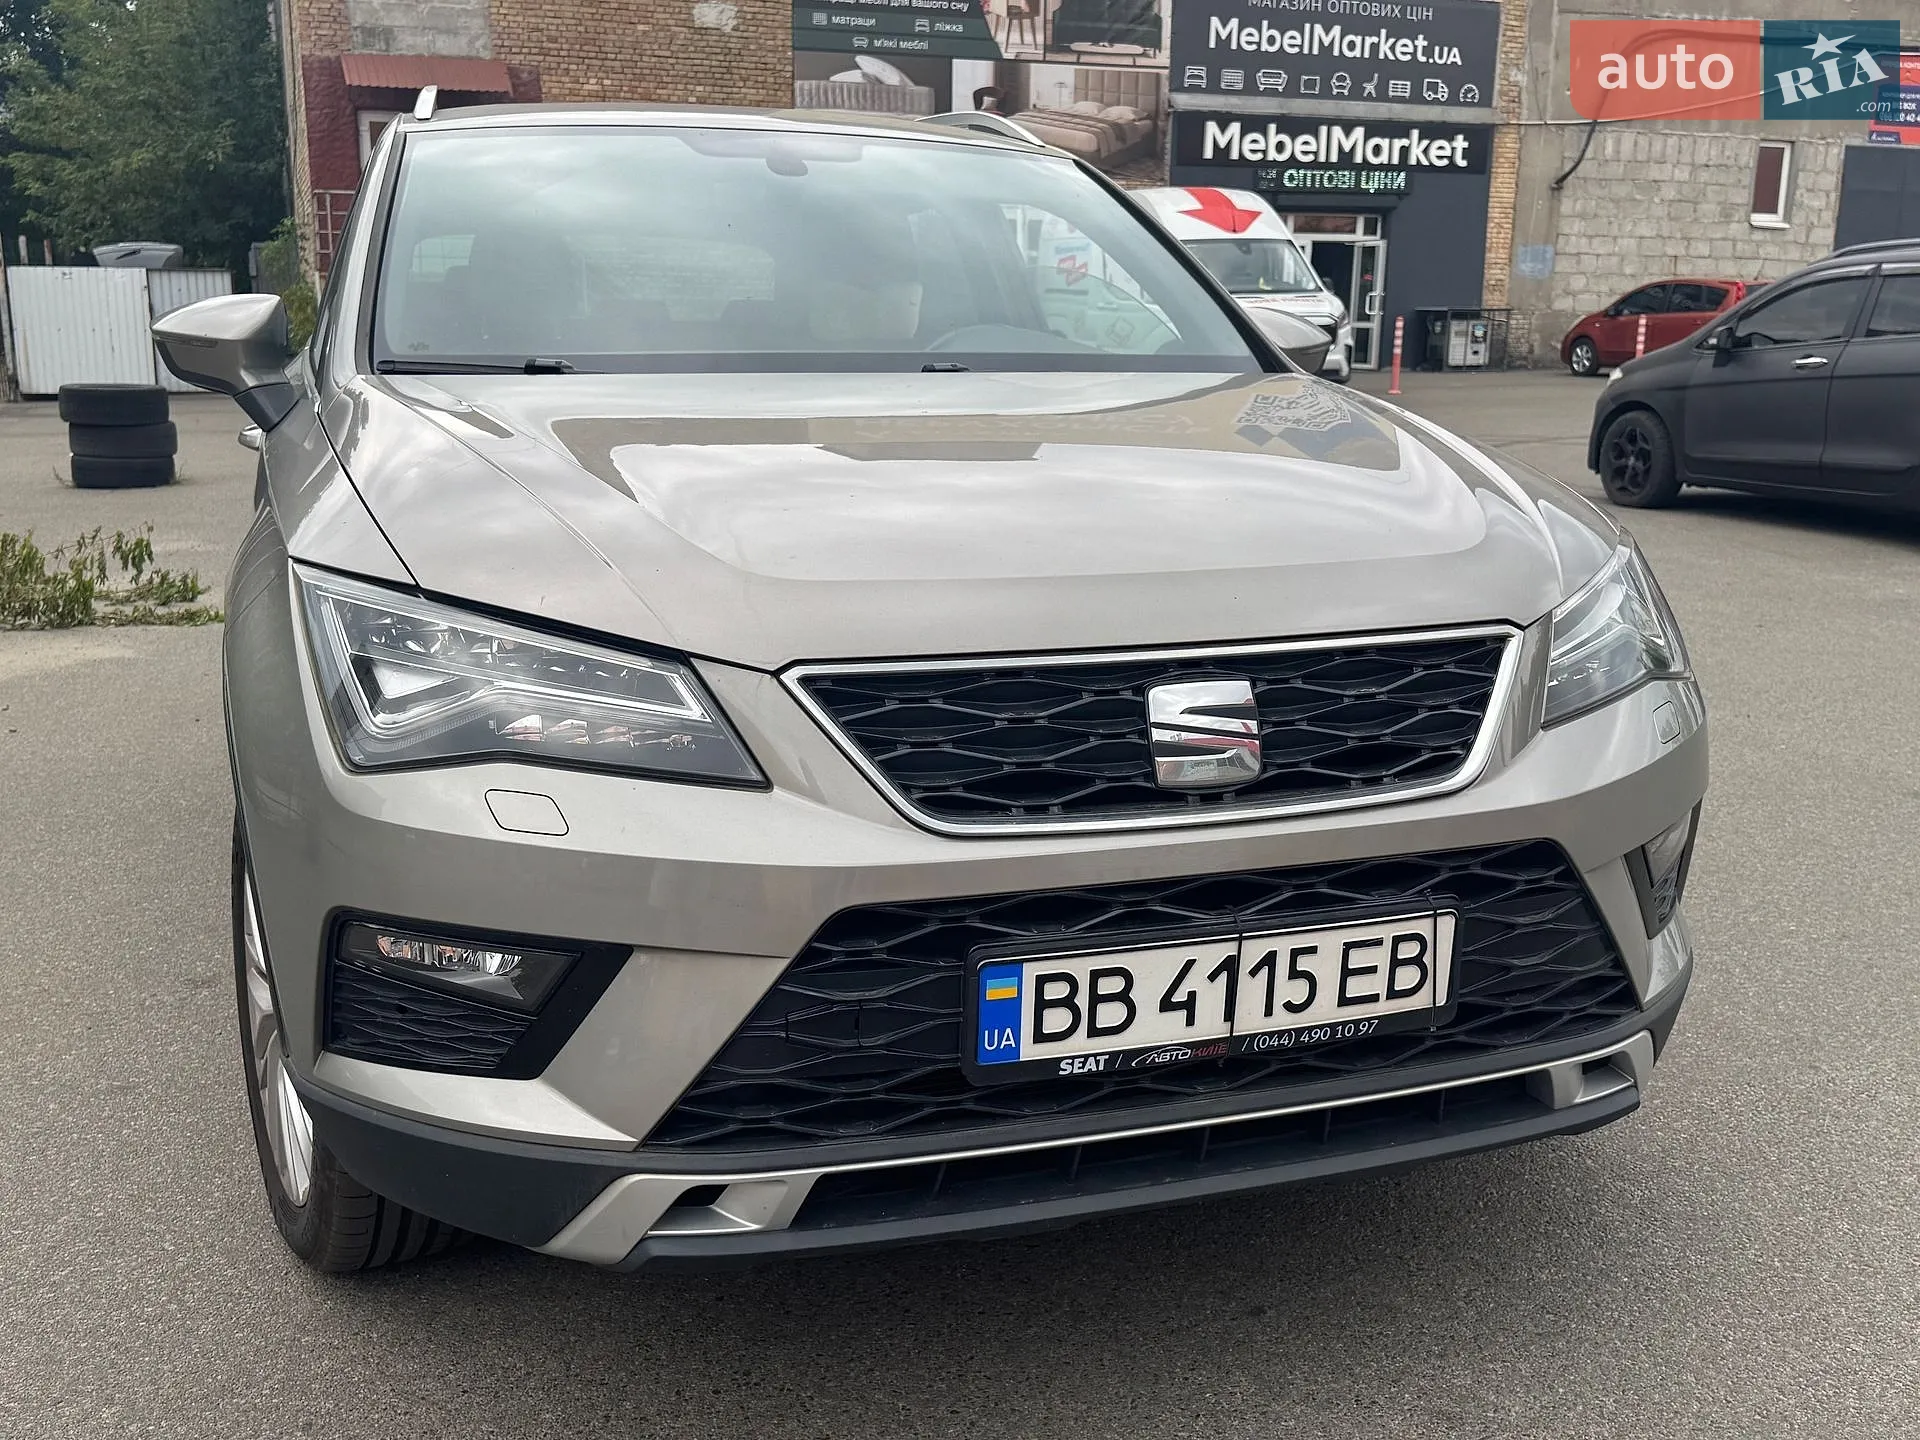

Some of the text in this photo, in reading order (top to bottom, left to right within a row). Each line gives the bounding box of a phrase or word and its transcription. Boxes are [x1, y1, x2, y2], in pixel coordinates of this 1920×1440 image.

[950, 2, 969, 12] сну
[1327, 0, 1402, 18] ОПТОВИХ
[1406, 6, 1434, 22] ЦІН
[831, 15, 876, 27] матраци
[934, 22, 964, 32] ліжка
[899, 40, 929, 50] меблі
[1208, 16, 1463, 66] MebelMarket.UA
[1201, 120, 1470, 168] MebelMarket
[1283, 168, 1356, 188] ОПТОВІ
[1360, 170, 1407, 194] ЦІНИ
[1032, 931, 1430, 1045] BB 4115 EB
[984, 1027, 1016, 1051] UA
[1059, 1054, 1110, 1075] SEAT
[1253, 1030, 1297, 1052] (044)
[1300, 1027, 1331, 1044] 490
[1335, 1023, 1355, 1040] 10
[1358, 1019, 1379, 1036] 97
